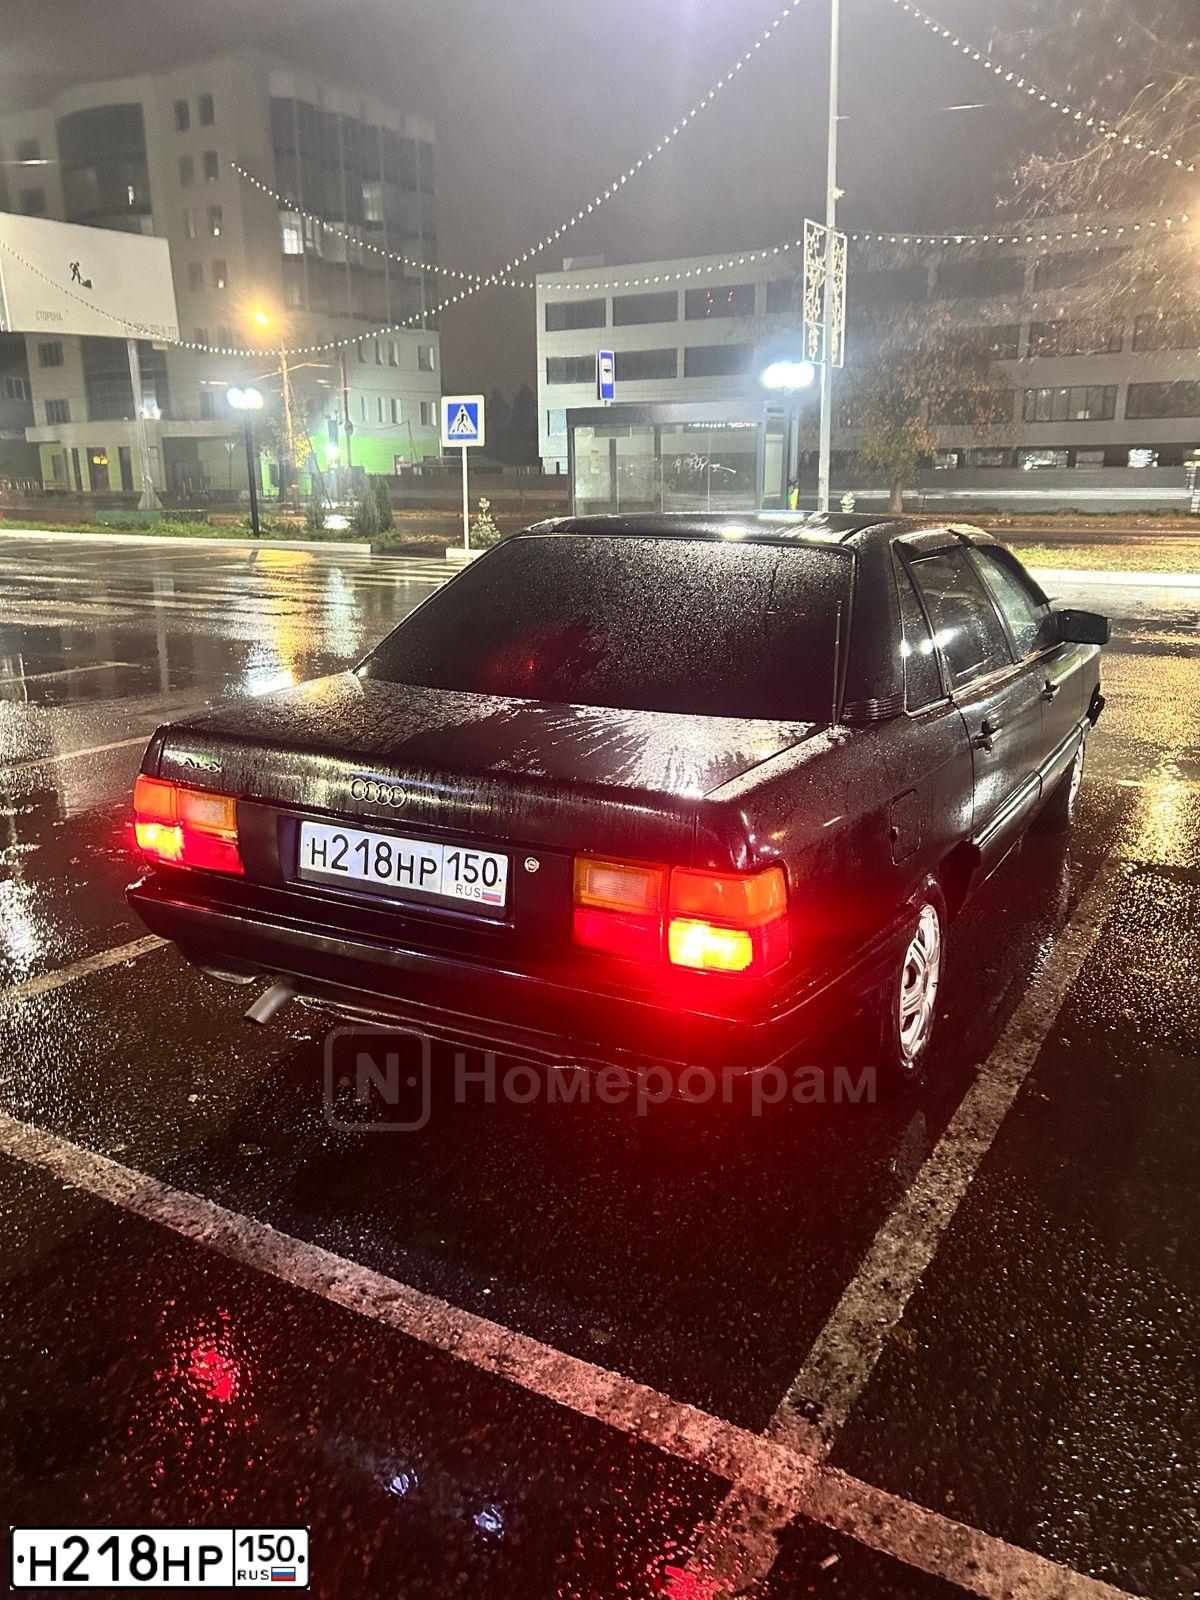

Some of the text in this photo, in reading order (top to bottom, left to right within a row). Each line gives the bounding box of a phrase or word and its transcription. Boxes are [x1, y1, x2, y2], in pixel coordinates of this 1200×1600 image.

[310, 834, 437, 885] Н218НР
[446, 851, 499, 888] 150
[455, 883, 481, 899] RUS
